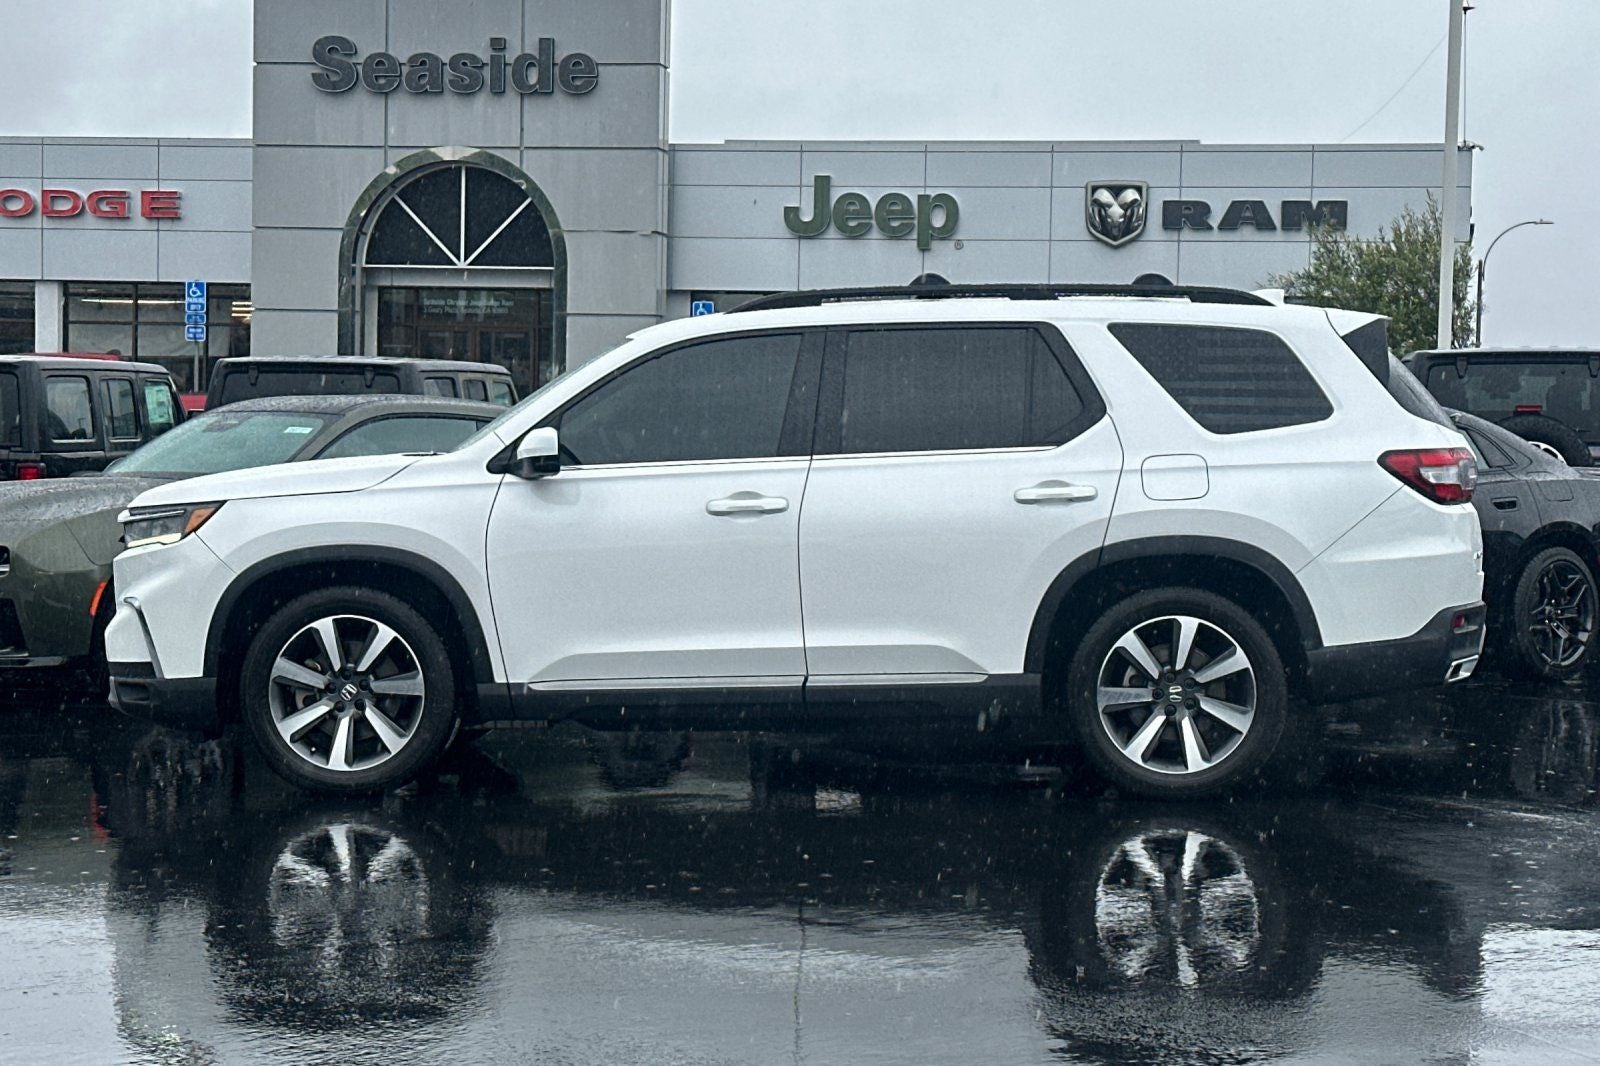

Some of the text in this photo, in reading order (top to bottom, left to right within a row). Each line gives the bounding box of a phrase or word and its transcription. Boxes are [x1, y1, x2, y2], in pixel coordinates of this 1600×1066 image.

[311, 35, 598, 94] Seaside
[0, 189, 182, 218] ODGE
[784, 175, 959, 250] Jeep
[1162, 200, 1348, 230] RAM
